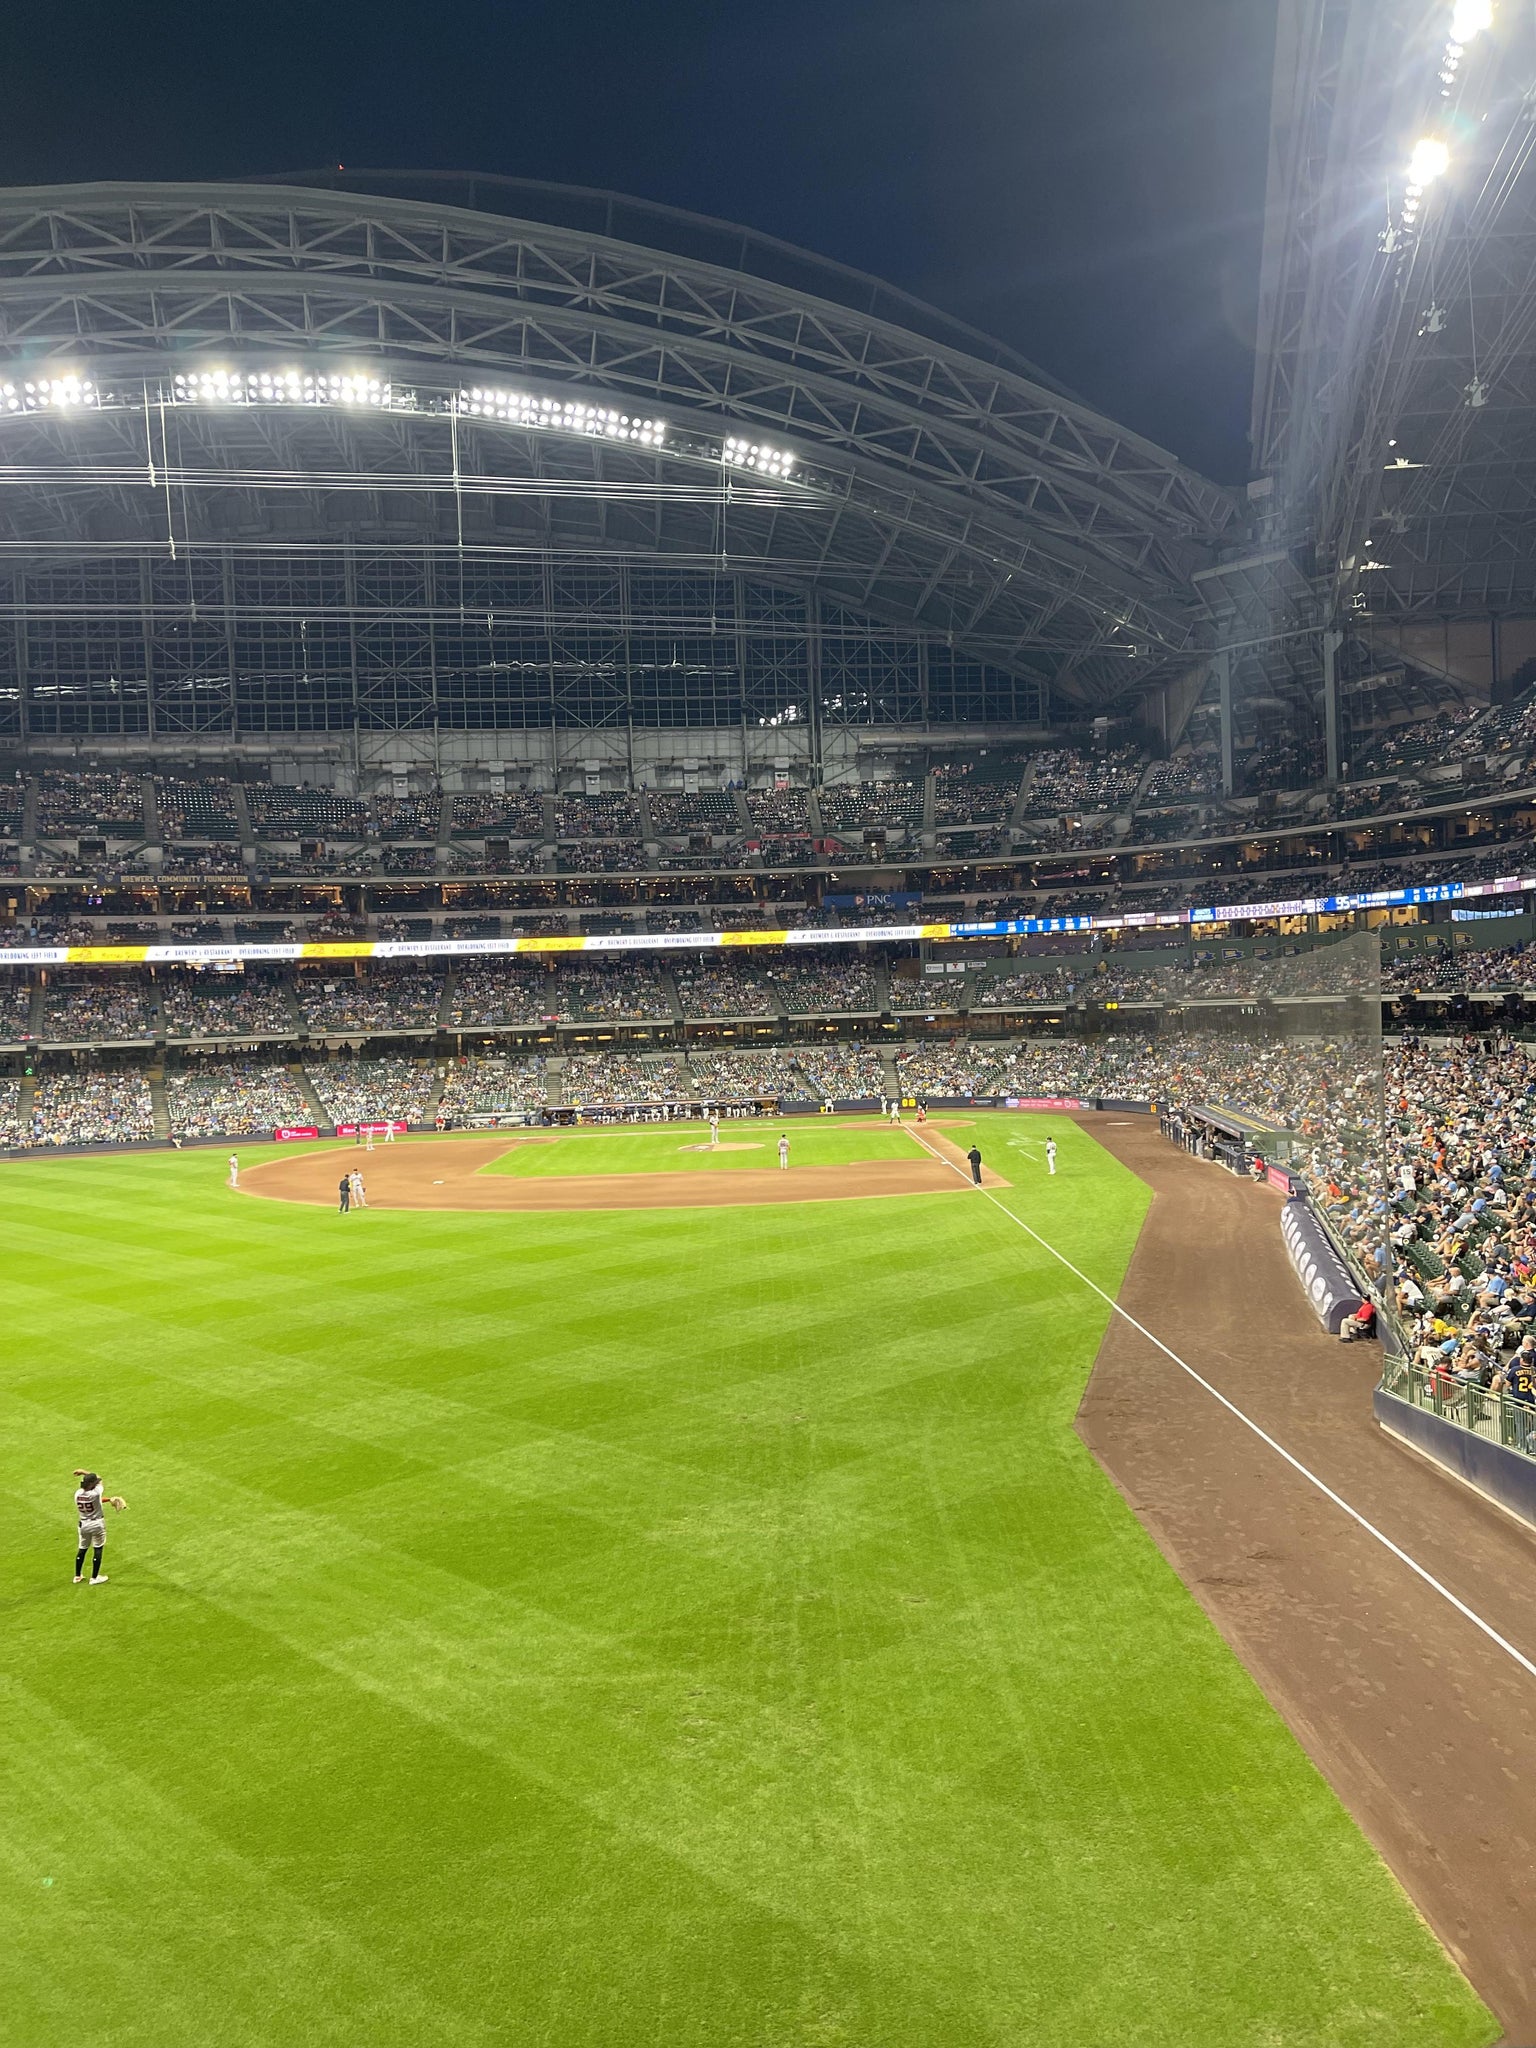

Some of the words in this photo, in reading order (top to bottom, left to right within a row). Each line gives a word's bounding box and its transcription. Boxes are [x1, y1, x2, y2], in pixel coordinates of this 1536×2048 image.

[867, 894, 891, 904] PNC
[1336, 896, 1350, 910] 95
[77, 1502, 94, 1513] 29
